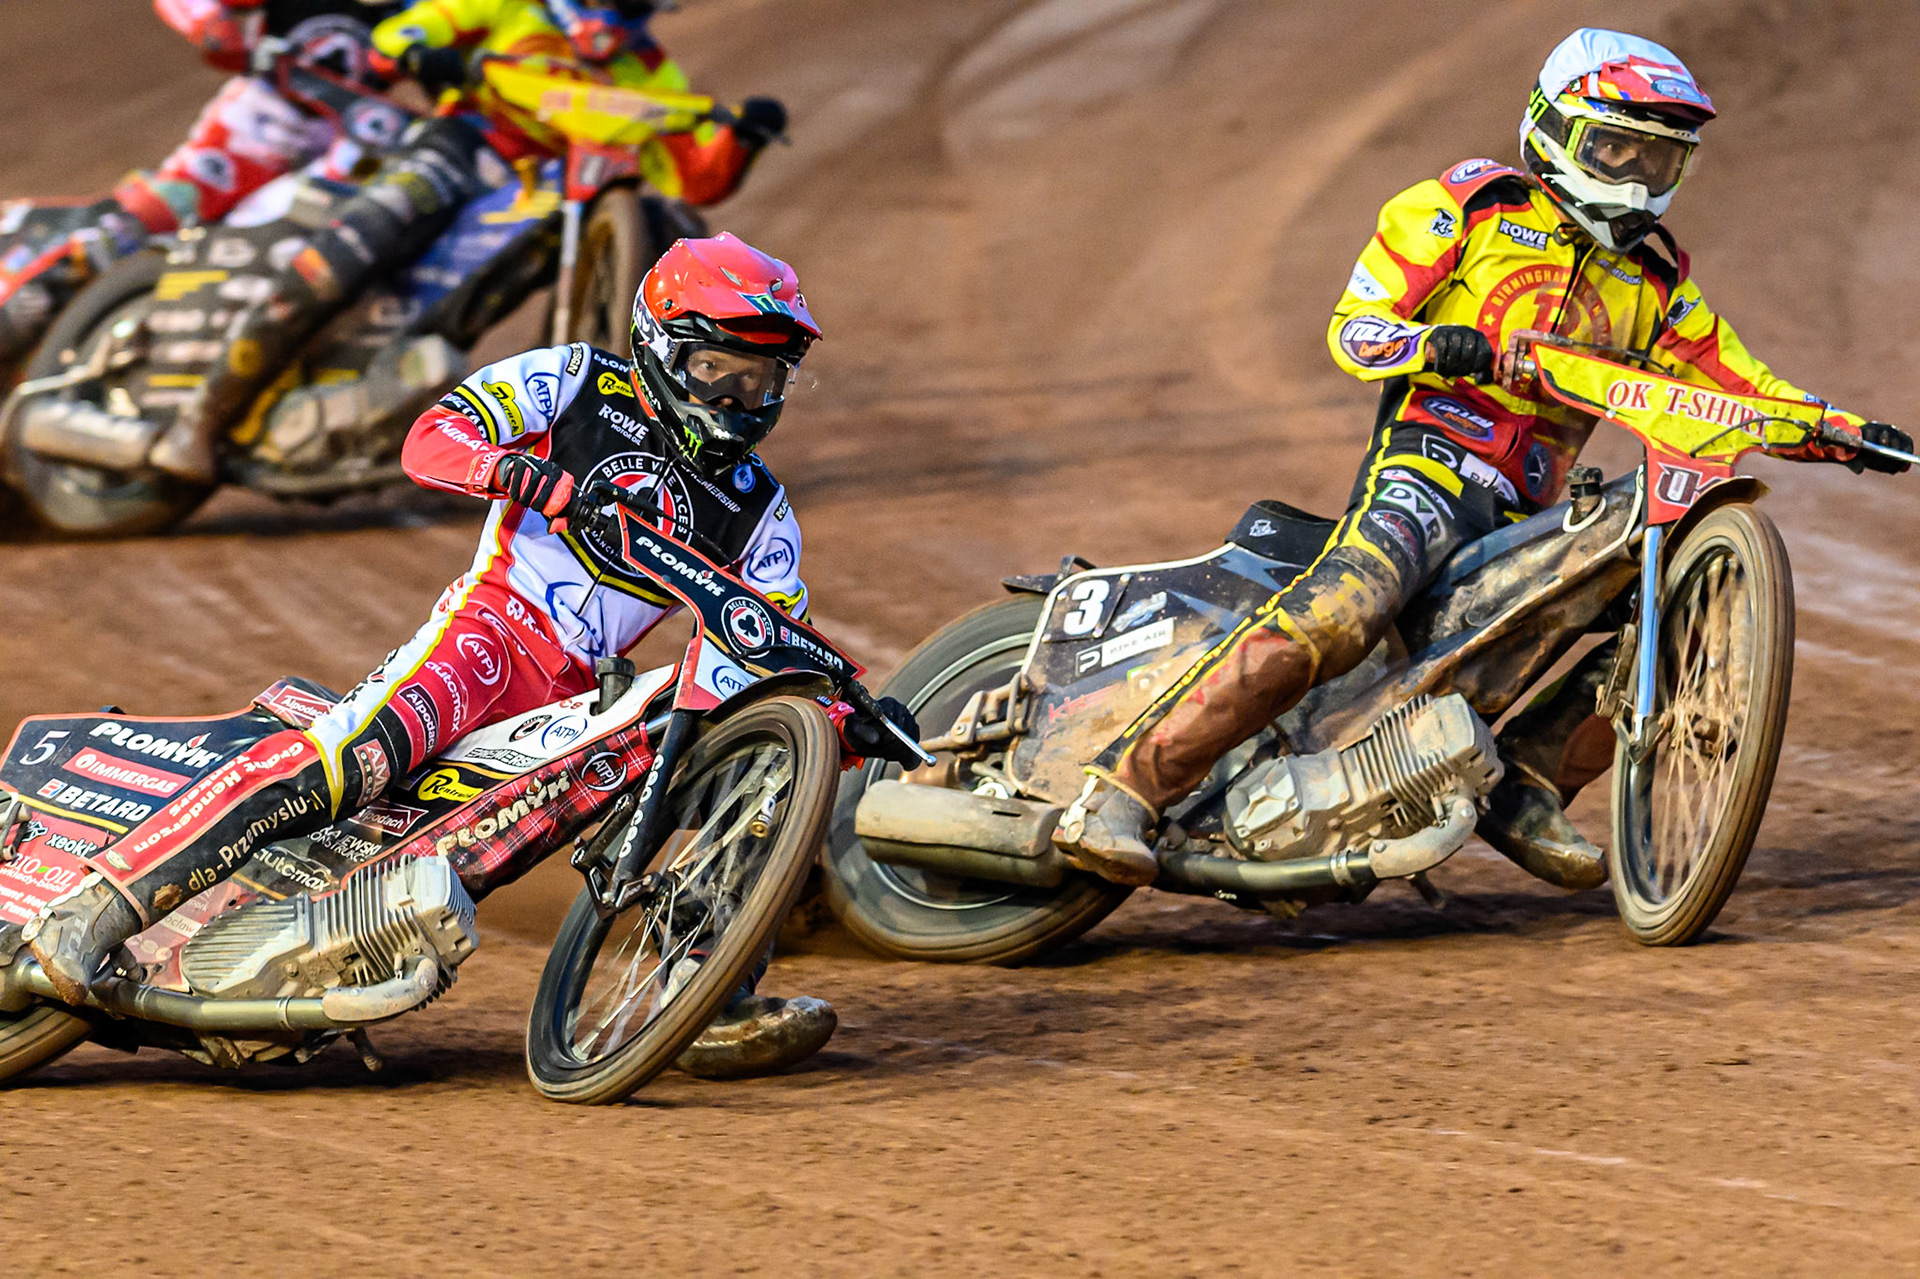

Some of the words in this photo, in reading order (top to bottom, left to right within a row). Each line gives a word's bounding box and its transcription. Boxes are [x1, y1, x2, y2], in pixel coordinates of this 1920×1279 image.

[1500, 220, 1549, 245] ROWE
[446, 394, 490, 444] BETAR
[597, 403, 650, 441] ROWE
[1608, 381, 1653, 409] OK
[1666, 386, 1769, 439] T-SHIRT
[610, 423, 632, 442] MOTOR
[631, 435, 643, 447] OIL
[601, 456, 644, 479] BELLE
[674, 493, 690, 534] ACES
[756, 548, 790, 572] ATPI
[1063, 580, 1110, 635] 3
[465, 639, 494, 676] ATPI
[407, 691, 436, 754] Alpodach
[549, 725, 580, 741] ATPI
[19, 731, 70, 765] 5
[246, 741, 304, 772] Grant
[90, 762, 179, 793] IMMERGAS
[169, 754, 250, 817] Tankers
[593, 757, 617, 785] ATPI
[56, 786, 152, 822] BETARD
[133, 769, 242, 853] Henderson
